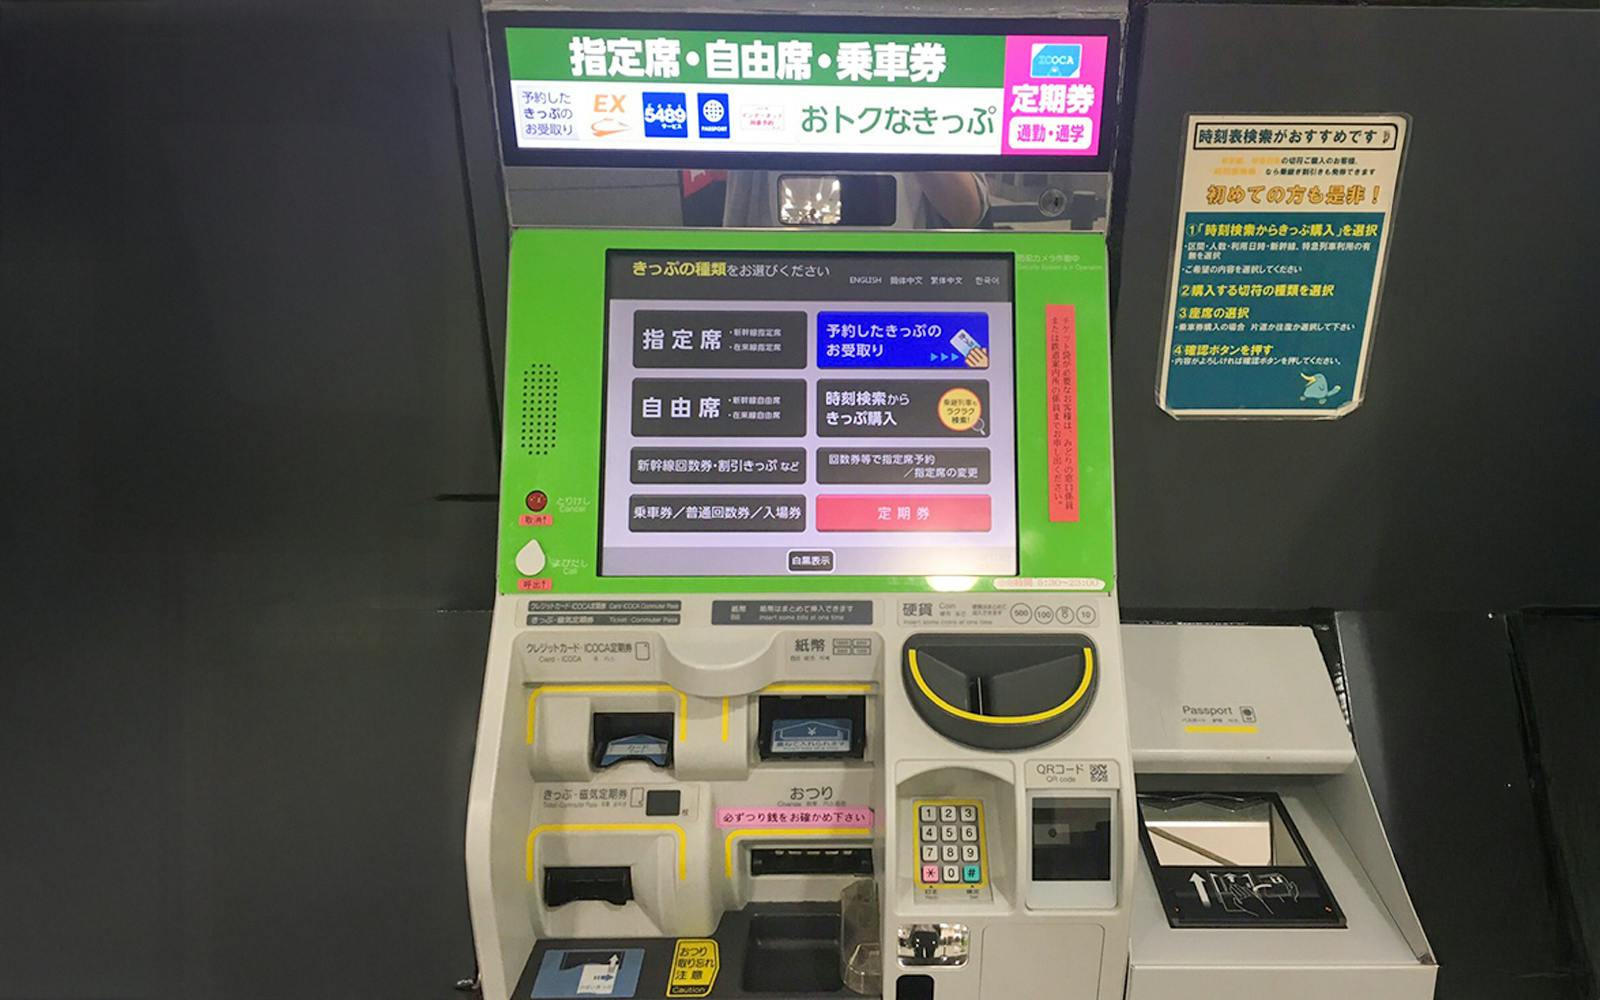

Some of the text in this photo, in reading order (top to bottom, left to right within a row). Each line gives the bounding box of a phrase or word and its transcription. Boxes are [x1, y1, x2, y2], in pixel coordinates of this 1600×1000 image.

[568, 35, 947, 83] 指定席・自由席・乗車券
[1037, 54, 1075, 66] ICOCA
[522, 91, 572, 105] 予約した
[593, 94, 626, 113] EX
[1011, 84, 1095, 114] 定期券
[523, 107, 573, 121] きっぷの
[644, 102, 687, 123] 5489
[801, 105, 997, 135] おトクなきっぷ
[525, 123, 574, 137] お受取り
[701, 125, 728, 133] PASSPORT
[1016, 124, 1085, 144] 通勤・通学
[1206, 184, 1382, 205] 初めての方も是非！
[849, 275, 882, 284] ENGLISH
[975, 275, 1000, 286] 한국어
[826, 323, 942, 338] 予約したきっぷの
[642, 328, 723, 350] 指定席
[826, 342, 883, 358] お受取り
[825, 391, 910, 407] 時刻検索から
[642, 396, 721, 419] 自由席
[826, 411, 897, 427] きっぷ購入
[828, 454, 936, 466] 回数券等で指定席予約
[559, 504, 586, 513] Cancel
[633, 505, 802, 519] 乗車券／普通回数券／入場券
[878, 506, 930, 521] 定期券
[791, 556, 831, 566] 白黒表示
[902, 602, 933, 617] 硬貨
[1013, 609, 1029, 618] 500
[1037, 610, 1052, 619] 100
[1081, 610, 1092, 618] 10
[794, 638, 826, 653] 紙幣
[1182, 705, 1233, 716] Passport
[1036, 764, 1085, 775] QRコード
[1046, 776, 1058, 784] QR
[789, 786, 833, 800] おつり
[723, 811, 867, 824] 必ずつり銭をお確かめ下さい
[925, 808, 932, 818] 1
[944, 808, 953, 818] 2
[964, 808, 972, 818] 3
[925, 828, 934, 837] 4
[945, 828, 953, 837] 5
[965, 828, 974, 837] 6
[926, 848, 934, 857] 7
[946, 848, 954, 858] 8
[966, 848, 975, 858] 9
[947, 868, 955, 878] 0
[679, 946, 708, 957] おつり
[677, 958, 715, 969] 取り忘れ
[674, 971, 703, 981] 注意
[671, 986, 707, 994] Caution
